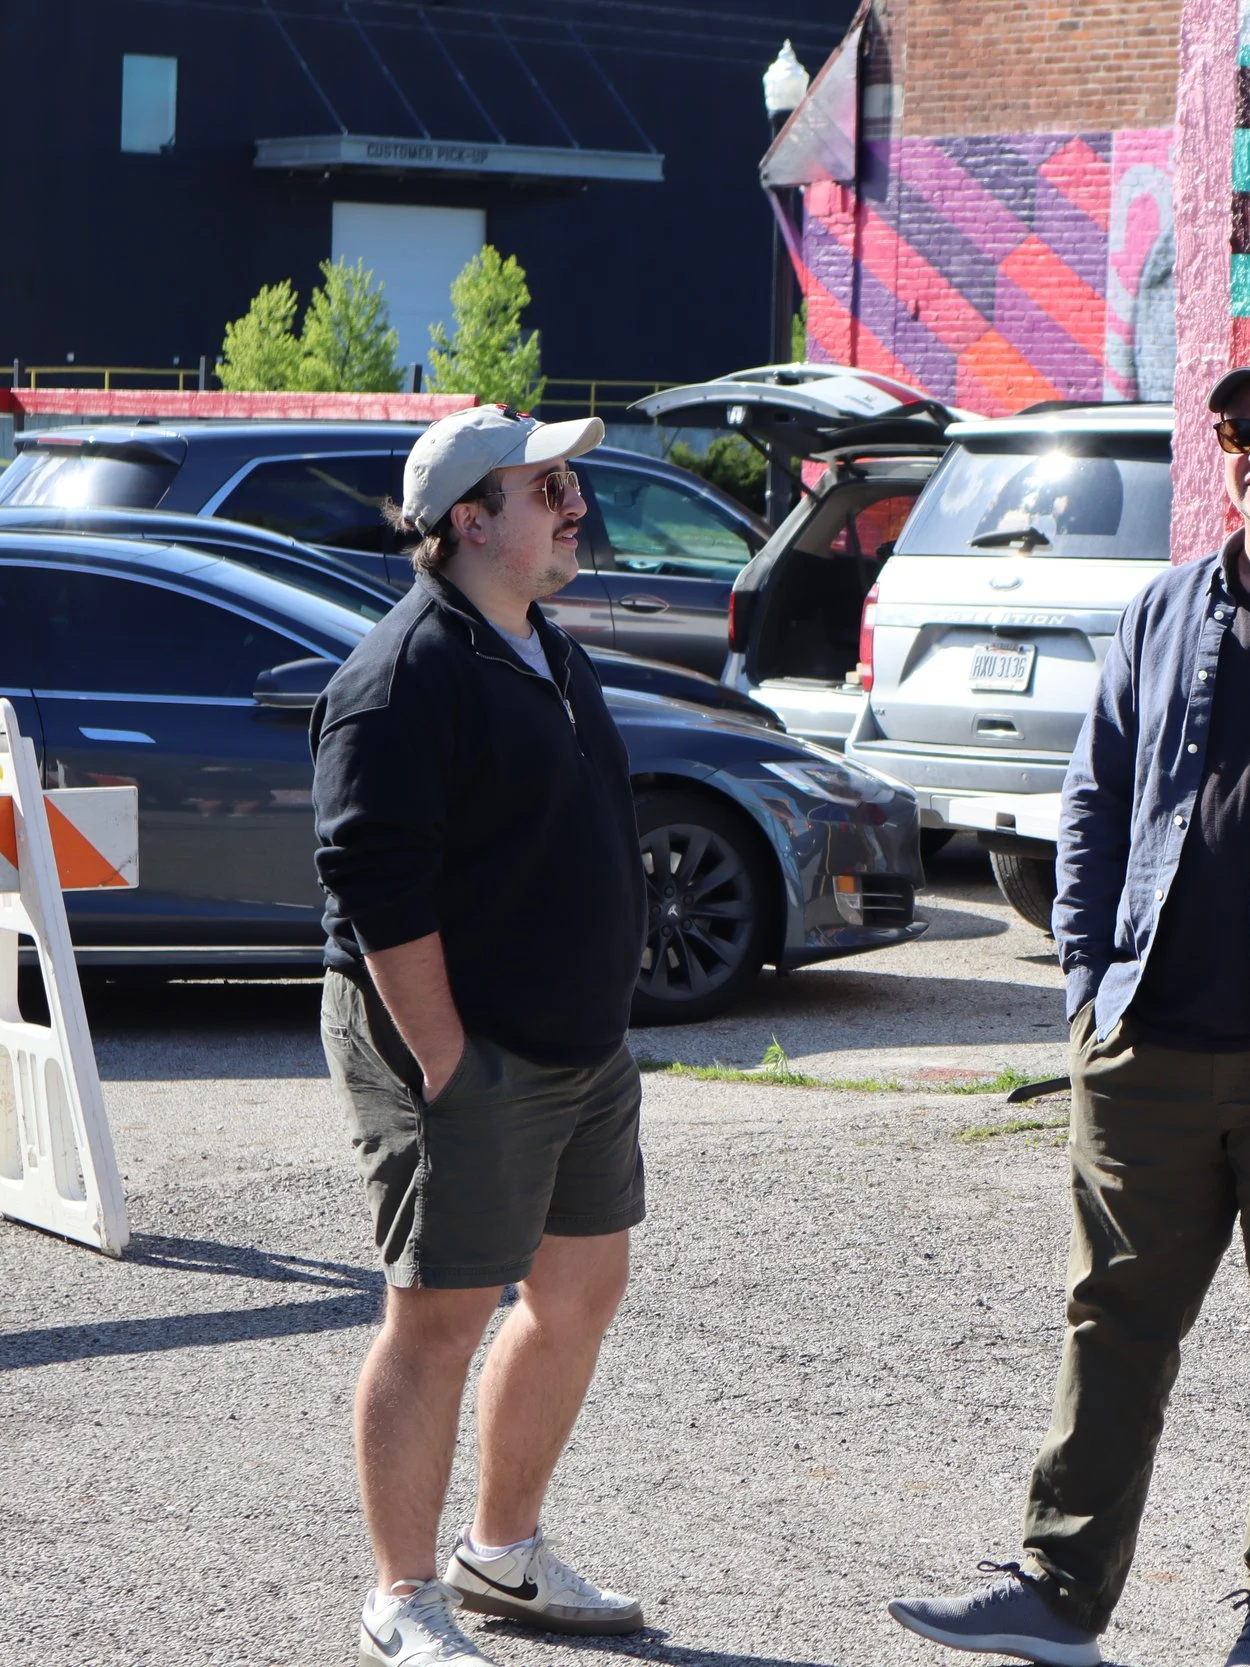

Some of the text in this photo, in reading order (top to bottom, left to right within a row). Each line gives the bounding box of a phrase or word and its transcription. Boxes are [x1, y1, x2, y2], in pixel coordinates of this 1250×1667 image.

[367, 142, 489, 164] CUSTOMER PICK-UP
[934, 611, 1066, 625] XPEITION
[972, 655, 997, 677] HXU
